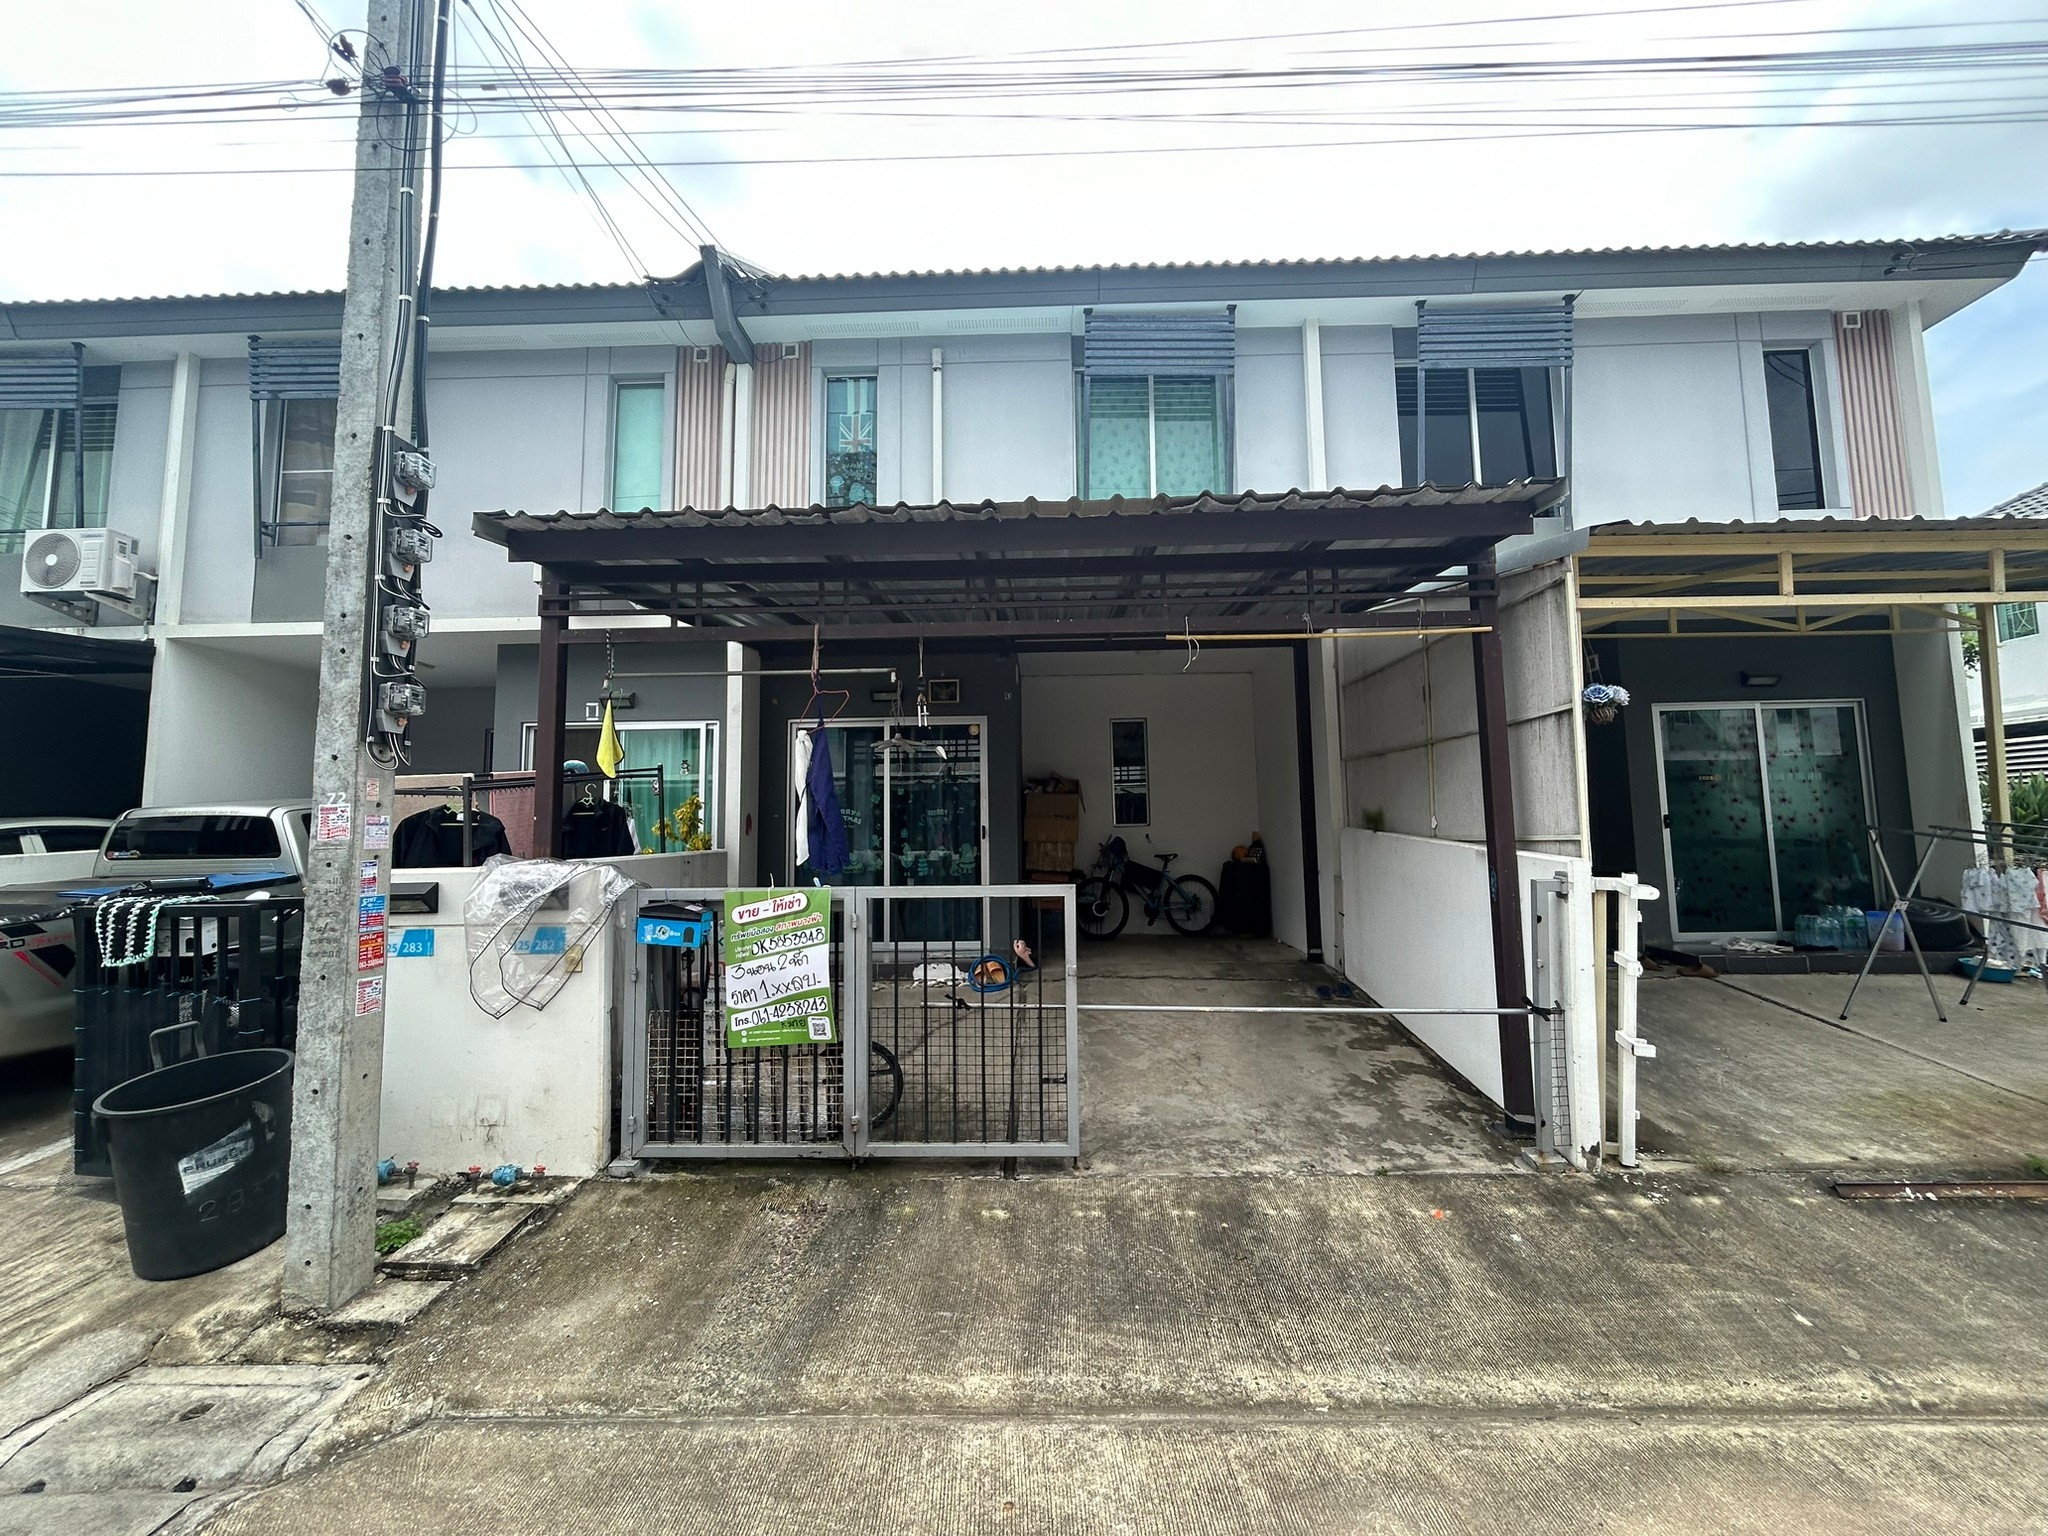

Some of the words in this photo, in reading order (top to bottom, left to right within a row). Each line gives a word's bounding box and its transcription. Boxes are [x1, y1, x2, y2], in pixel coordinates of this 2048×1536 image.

[326, 792, 346, 805] 72
[840, 808, 856, 816] RRY
[738, 907, 759, 919] ขาย
[772, 896, 801, 913] ให้เช่า
[387, 943, 398, 953] 25
[402, 942, 423, 953] 283
[534, 939, 555, 951] 282
[731, 988, 758, 1005] ราคา
[735, 1017, 751, 1027] โทร.
